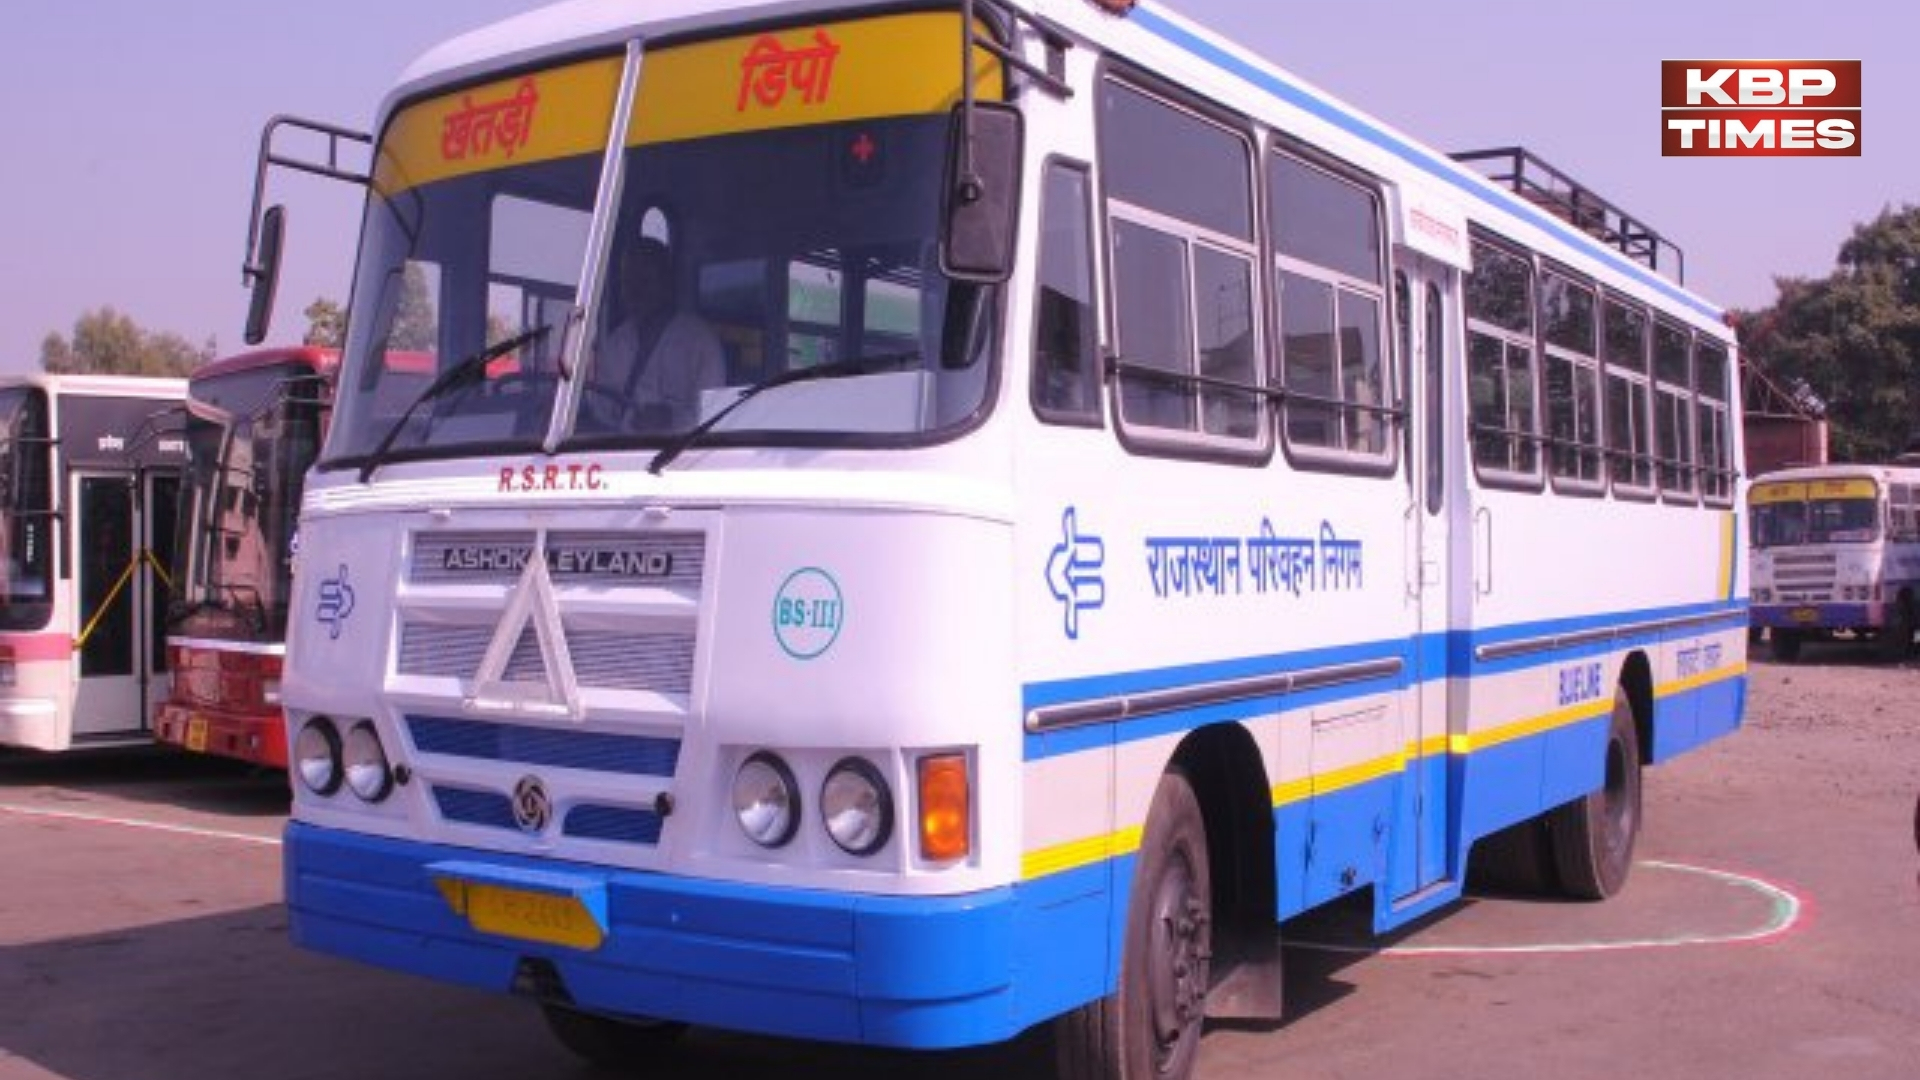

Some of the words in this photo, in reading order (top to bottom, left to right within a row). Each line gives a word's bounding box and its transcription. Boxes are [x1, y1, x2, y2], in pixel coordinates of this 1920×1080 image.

[440, 77, 540, 161] खेतड़ी
[736, 27, 842, 112] डिपो
[498, 463, 608, 491] R.S.R.T.C.
[446, 549, 529, 570] ASHOK
[1144, 536, 1242, 598] राजस्थान
[1246, 516, 1316, 598] परिवहन
[1318, 519, 1363, 591] निगम
